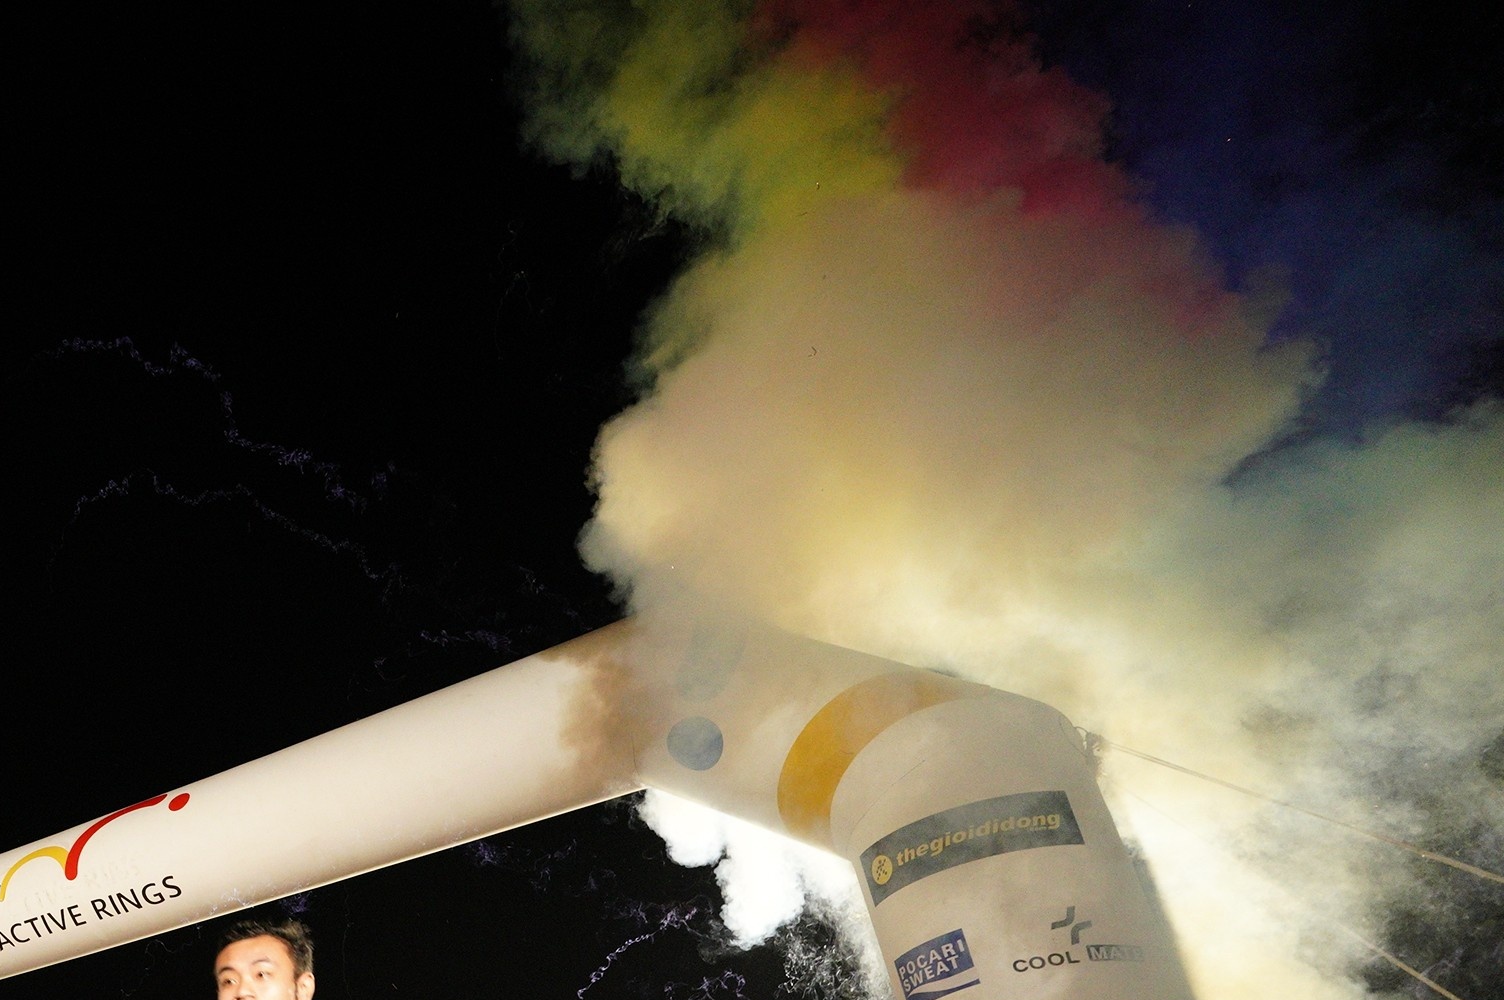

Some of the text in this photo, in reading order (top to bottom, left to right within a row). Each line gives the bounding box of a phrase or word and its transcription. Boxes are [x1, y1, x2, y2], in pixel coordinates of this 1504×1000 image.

[896, 813, 1061, 867] thegioididong
[90, 875, 183, 922] RINGS
[898, 939, 965, 980] POCARI
[903, 955, 960, 993] SWEAT
[1012, 951, 1081, 972] COOL
